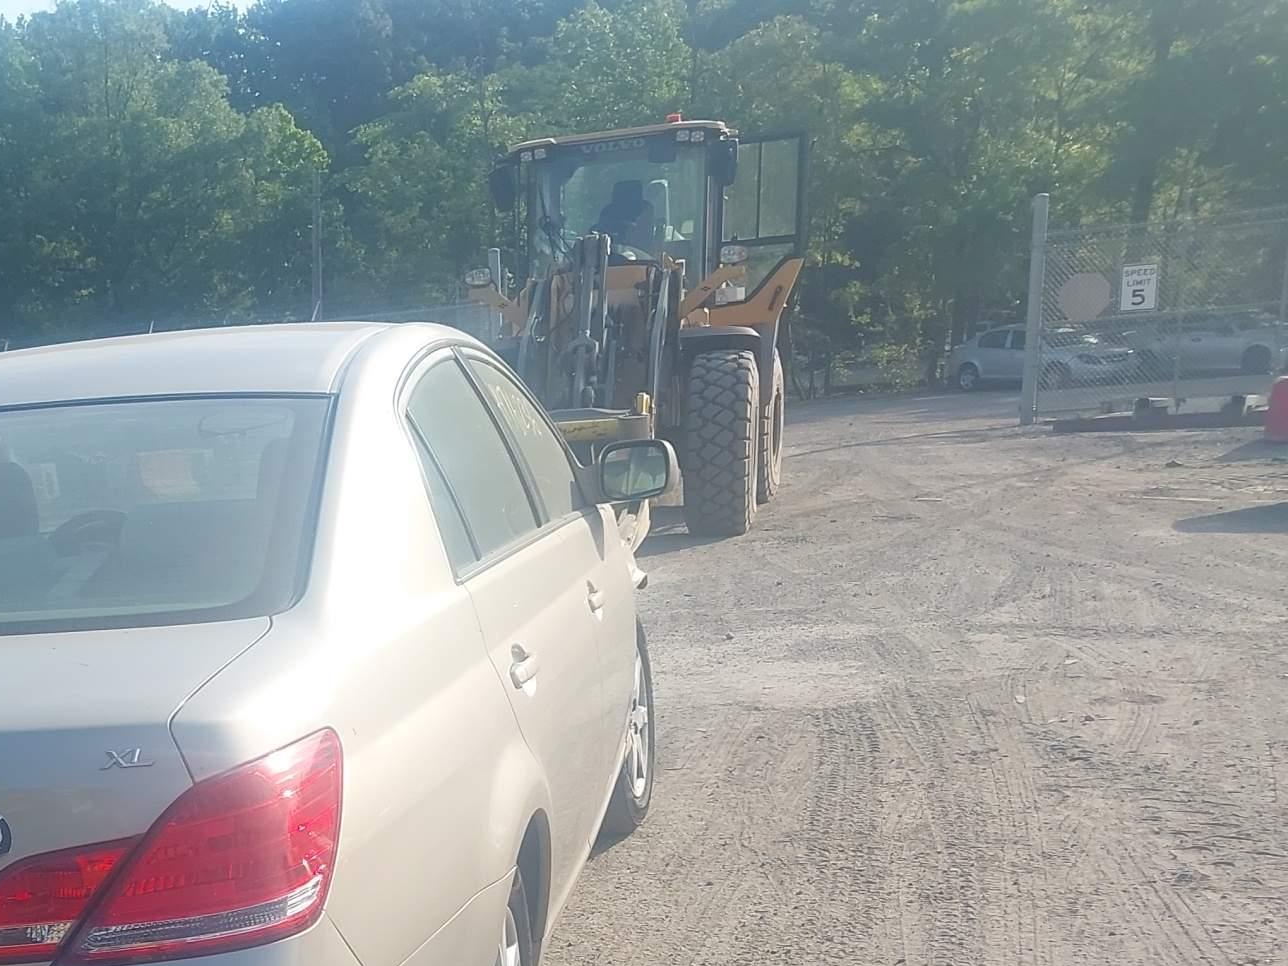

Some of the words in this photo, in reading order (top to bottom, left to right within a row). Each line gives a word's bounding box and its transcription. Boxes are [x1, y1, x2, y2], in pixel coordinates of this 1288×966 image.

[581, 138, 646, 154] VOLVO
[1124, 269, 1155, 277] SPEED
[1127, 278, 1152, 287] LIMIT
[1131, 289, 1145, 305] 5
[99, 748, 154, 771] XL
